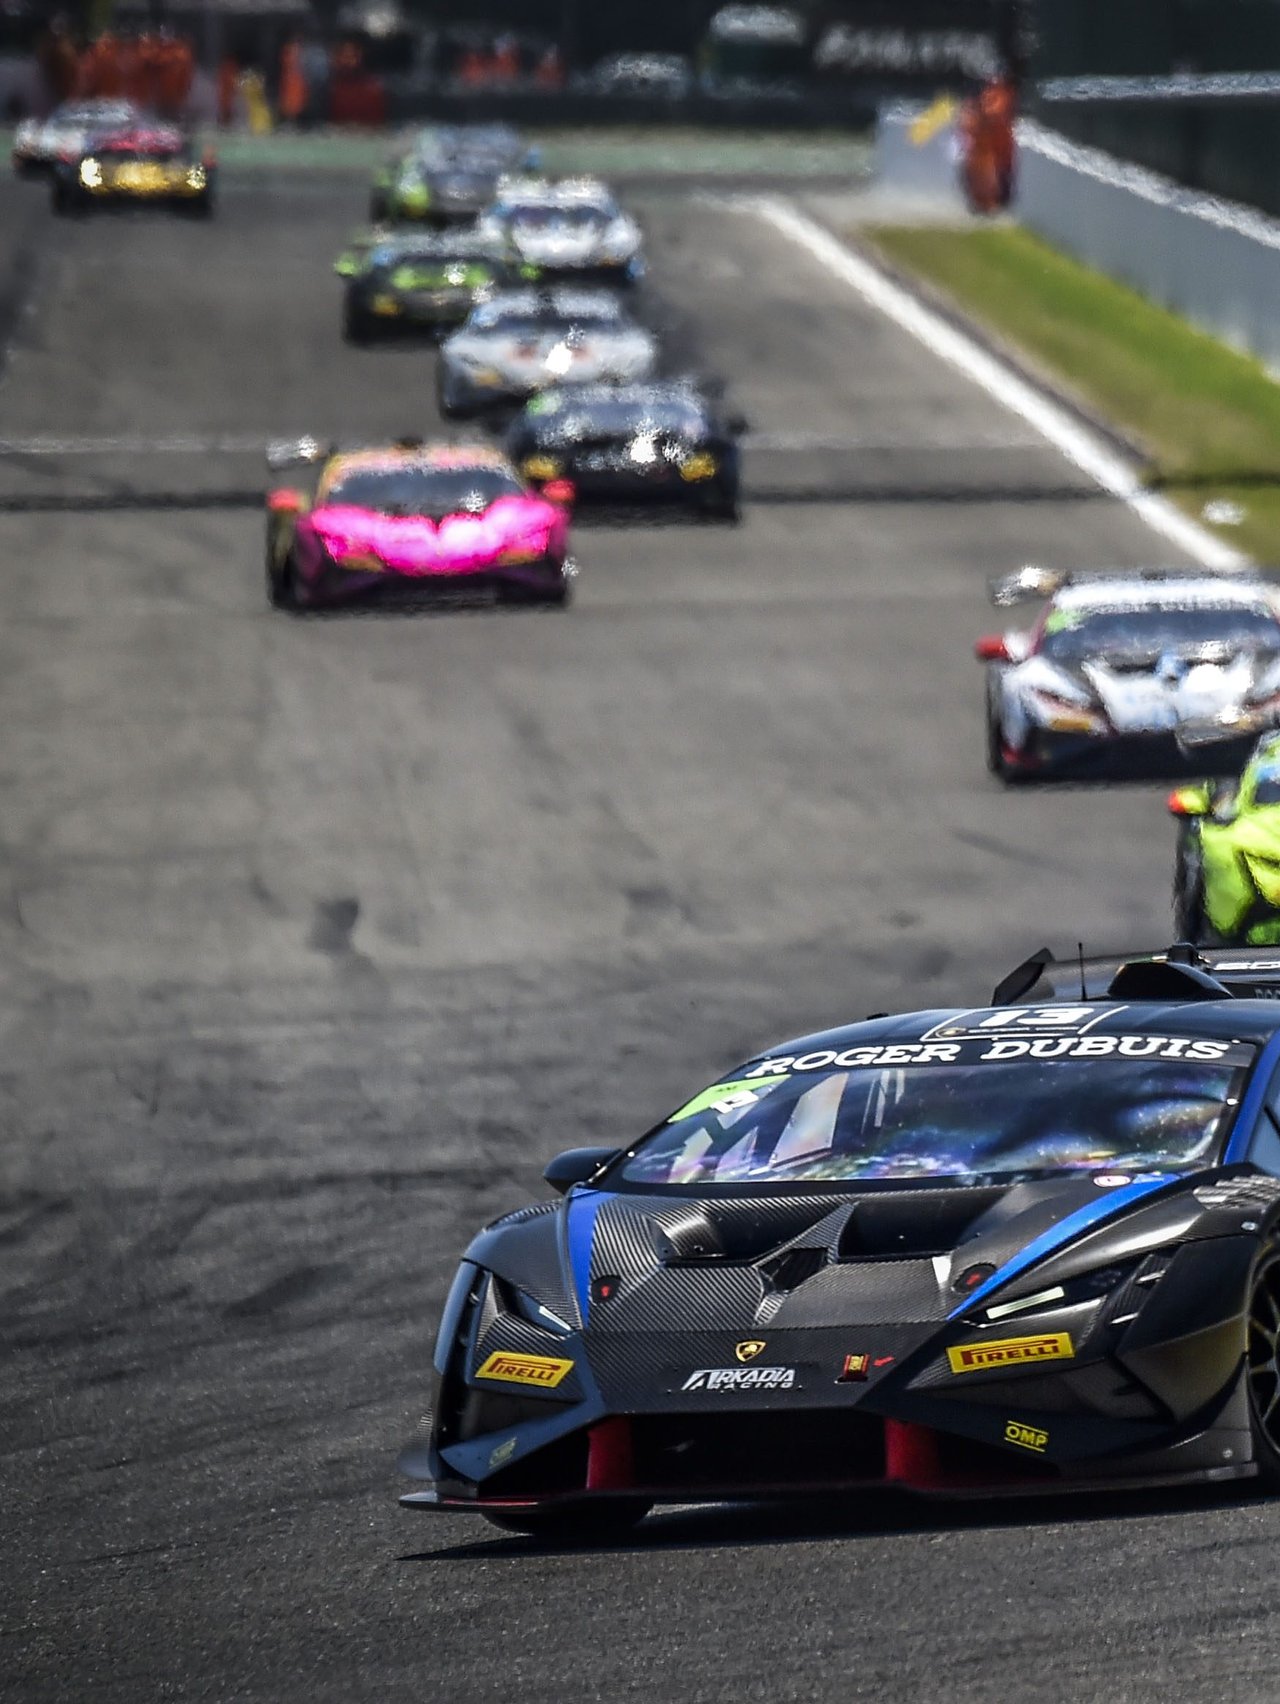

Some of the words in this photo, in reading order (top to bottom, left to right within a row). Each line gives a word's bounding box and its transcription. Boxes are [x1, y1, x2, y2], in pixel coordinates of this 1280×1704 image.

[980, 1008, 1095, 1028] 13
[745, 1044, 961, 1077] ROGER
[980, 1036, 1229, 1060] DUBUIS
[960, 1339, 1060, 1366] PIRELLI
[487, 1357, 561, 1381] PIRELLI
[681, 1367, 795, 1391] ARKADIA
[710, 1381, 795, 1390] RACING
[1005, 1425, 1047, 1447] OMP
